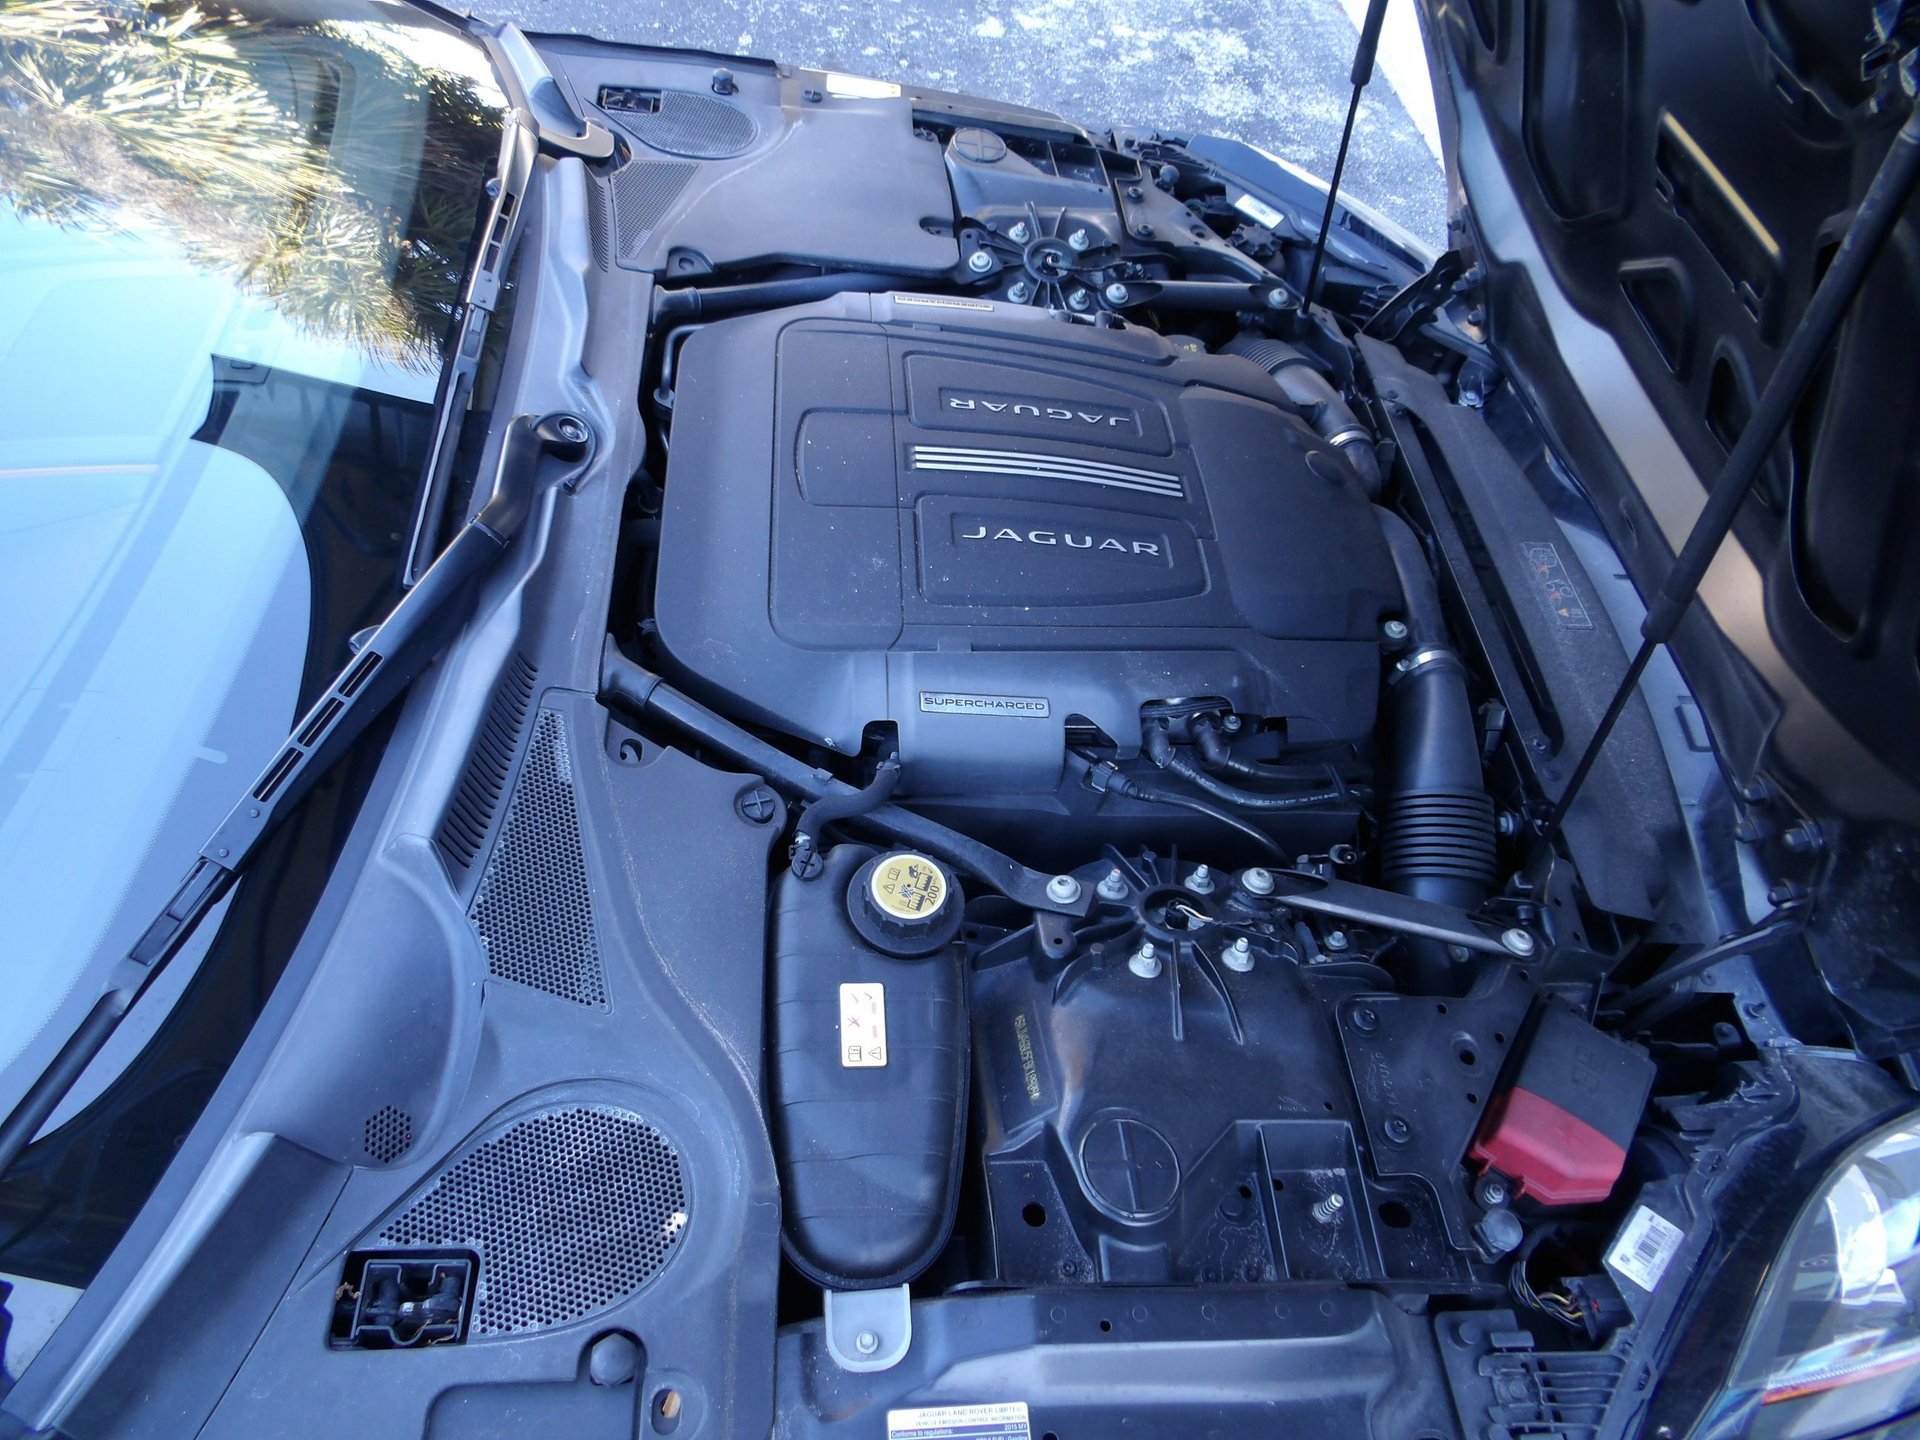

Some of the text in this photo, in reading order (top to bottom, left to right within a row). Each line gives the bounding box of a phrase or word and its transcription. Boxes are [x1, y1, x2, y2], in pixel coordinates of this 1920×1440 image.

[949, 398, 1130, 426] JAGUAR
[961, 526, 1160, 556] JAGUAR
[924, 697, 1045, 710] SUPERCHARGED
[925, 885, 940, 905] 200
[948, 1409, 967, 1417] LAND
[892, 1430, 917, 1438] Conforms
